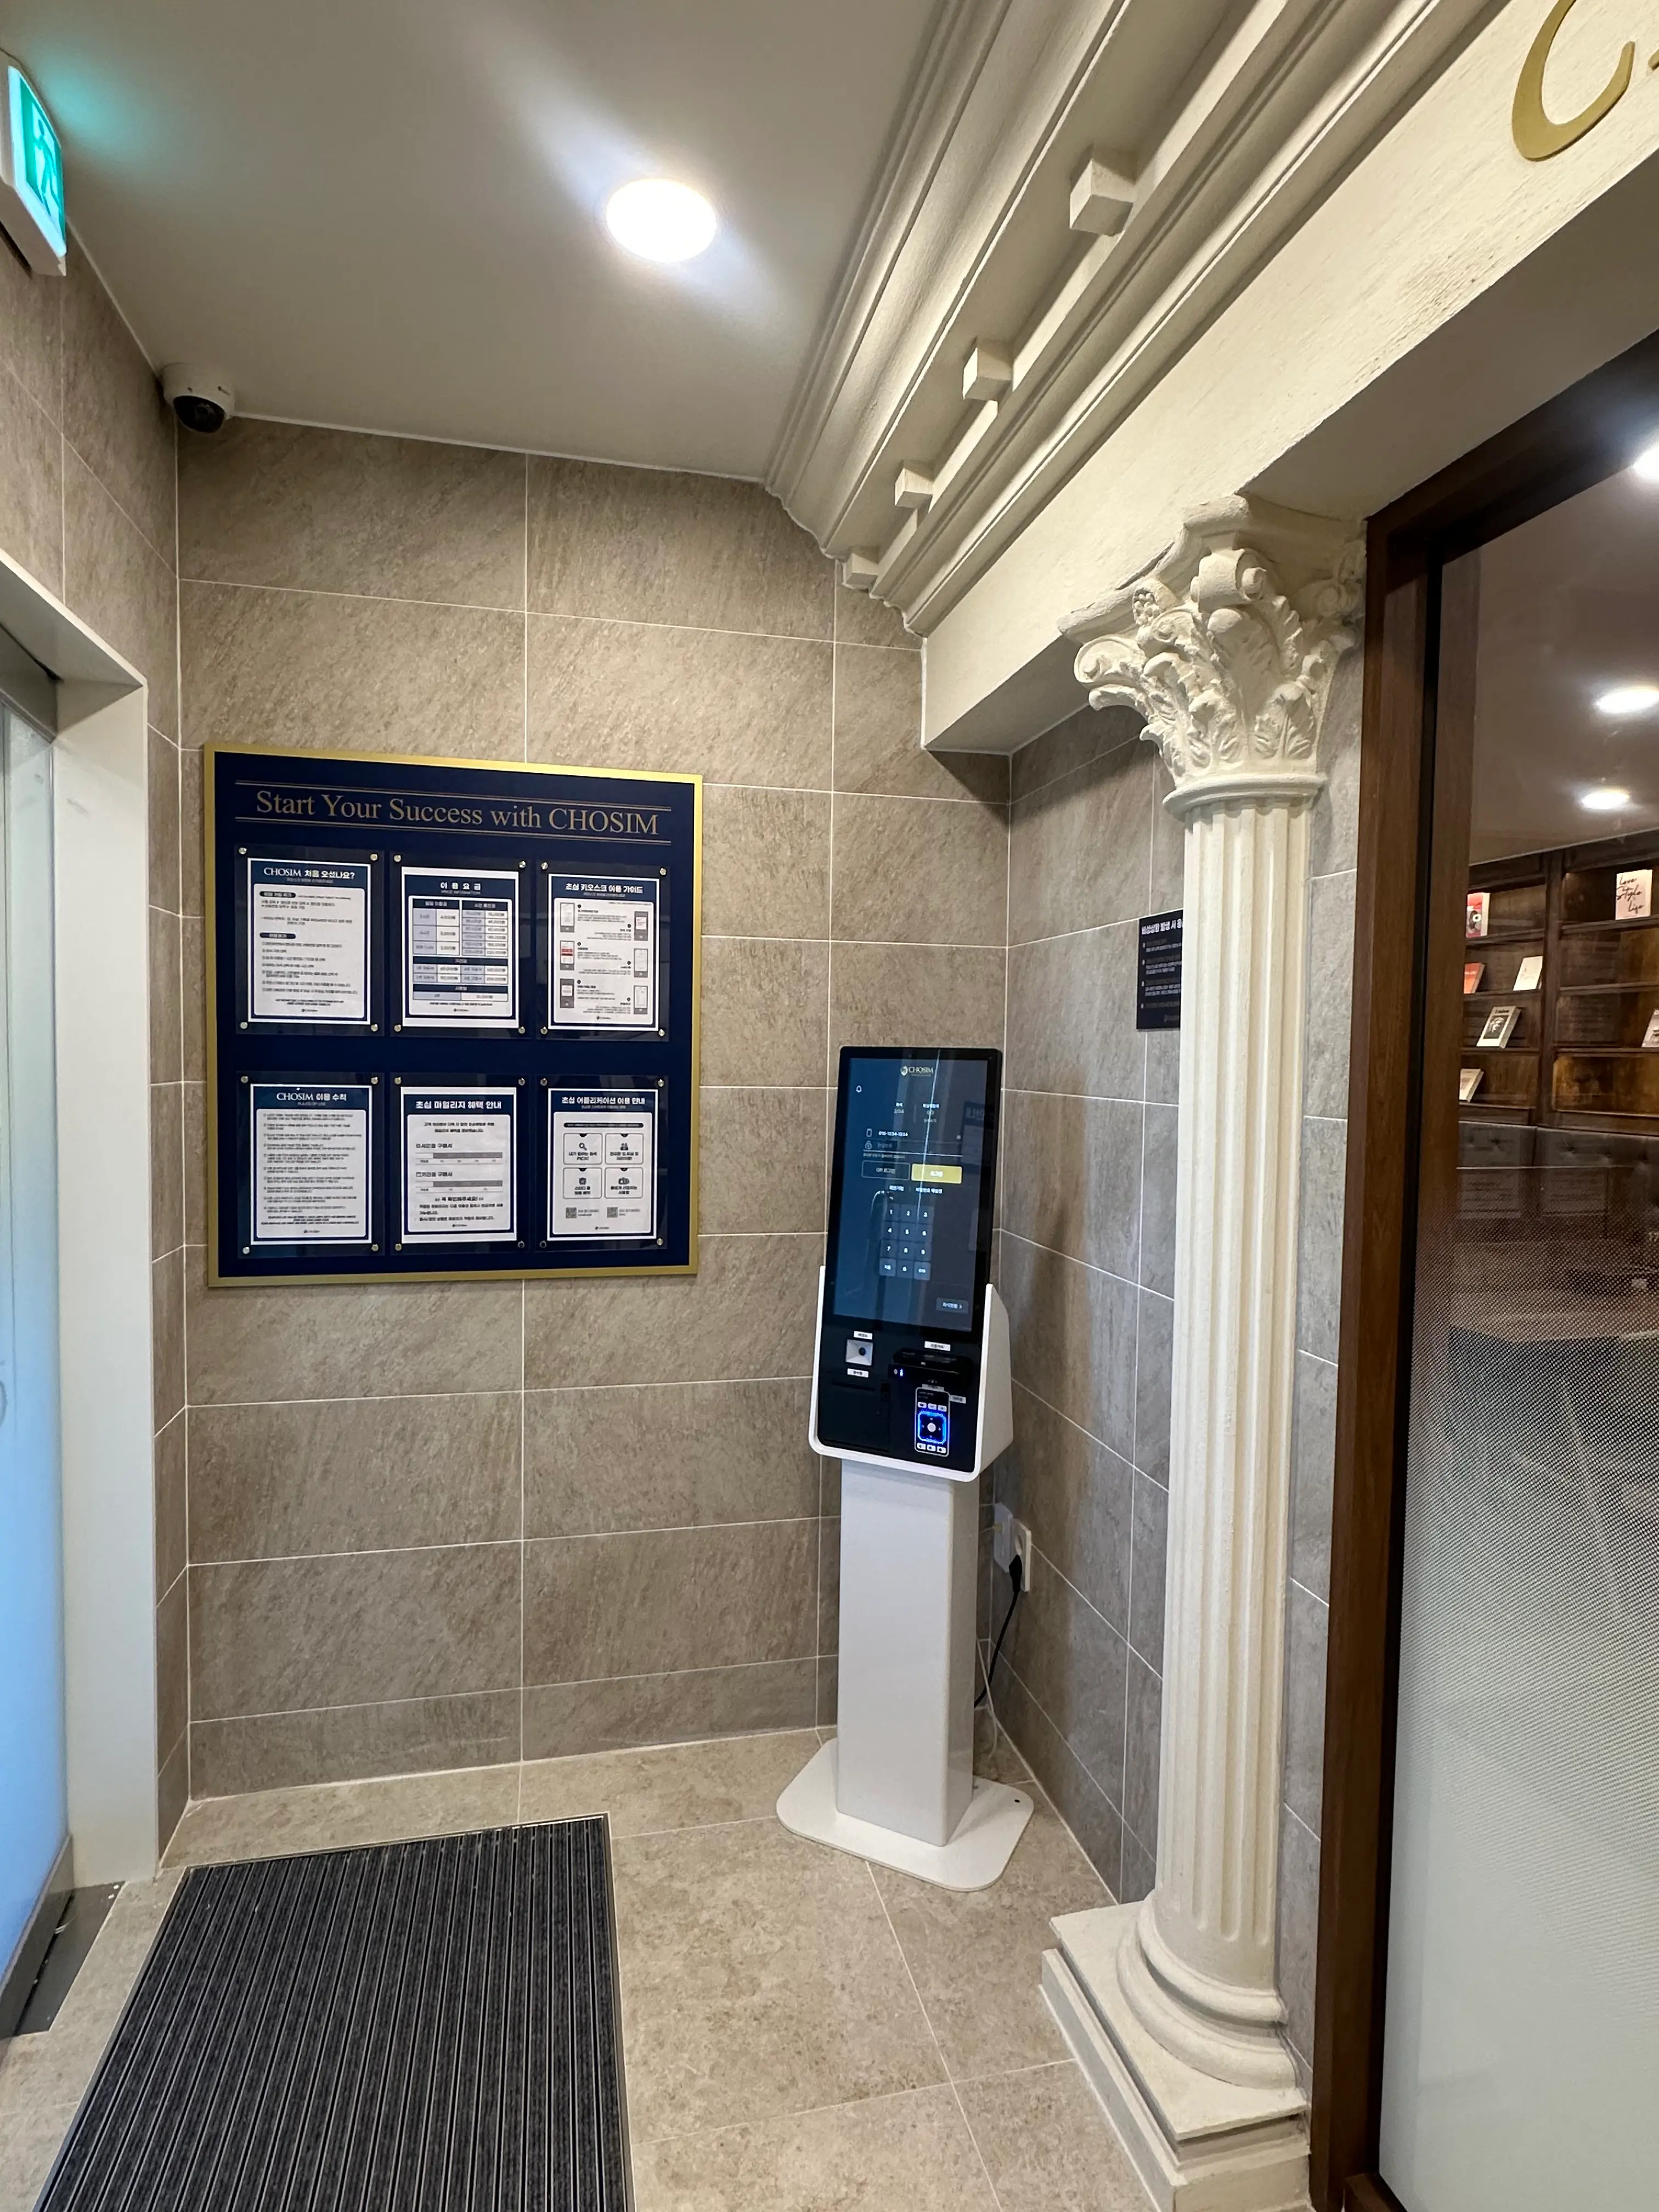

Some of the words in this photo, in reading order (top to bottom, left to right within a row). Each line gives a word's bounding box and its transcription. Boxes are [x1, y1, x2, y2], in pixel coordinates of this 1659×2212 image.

[257, 791, 315, 815] Start
[322, 794, 382, 819] Your
[390, 798, 483, 824] Success
[490, 805, 542, 828] with
[549, 808, 659, 835] CHOSIM
[263, 867, 301, 877] CHOSIM
[580, 884, 607, 892] 키오스크
[434, 1101, 466, 1109] 마일리지
